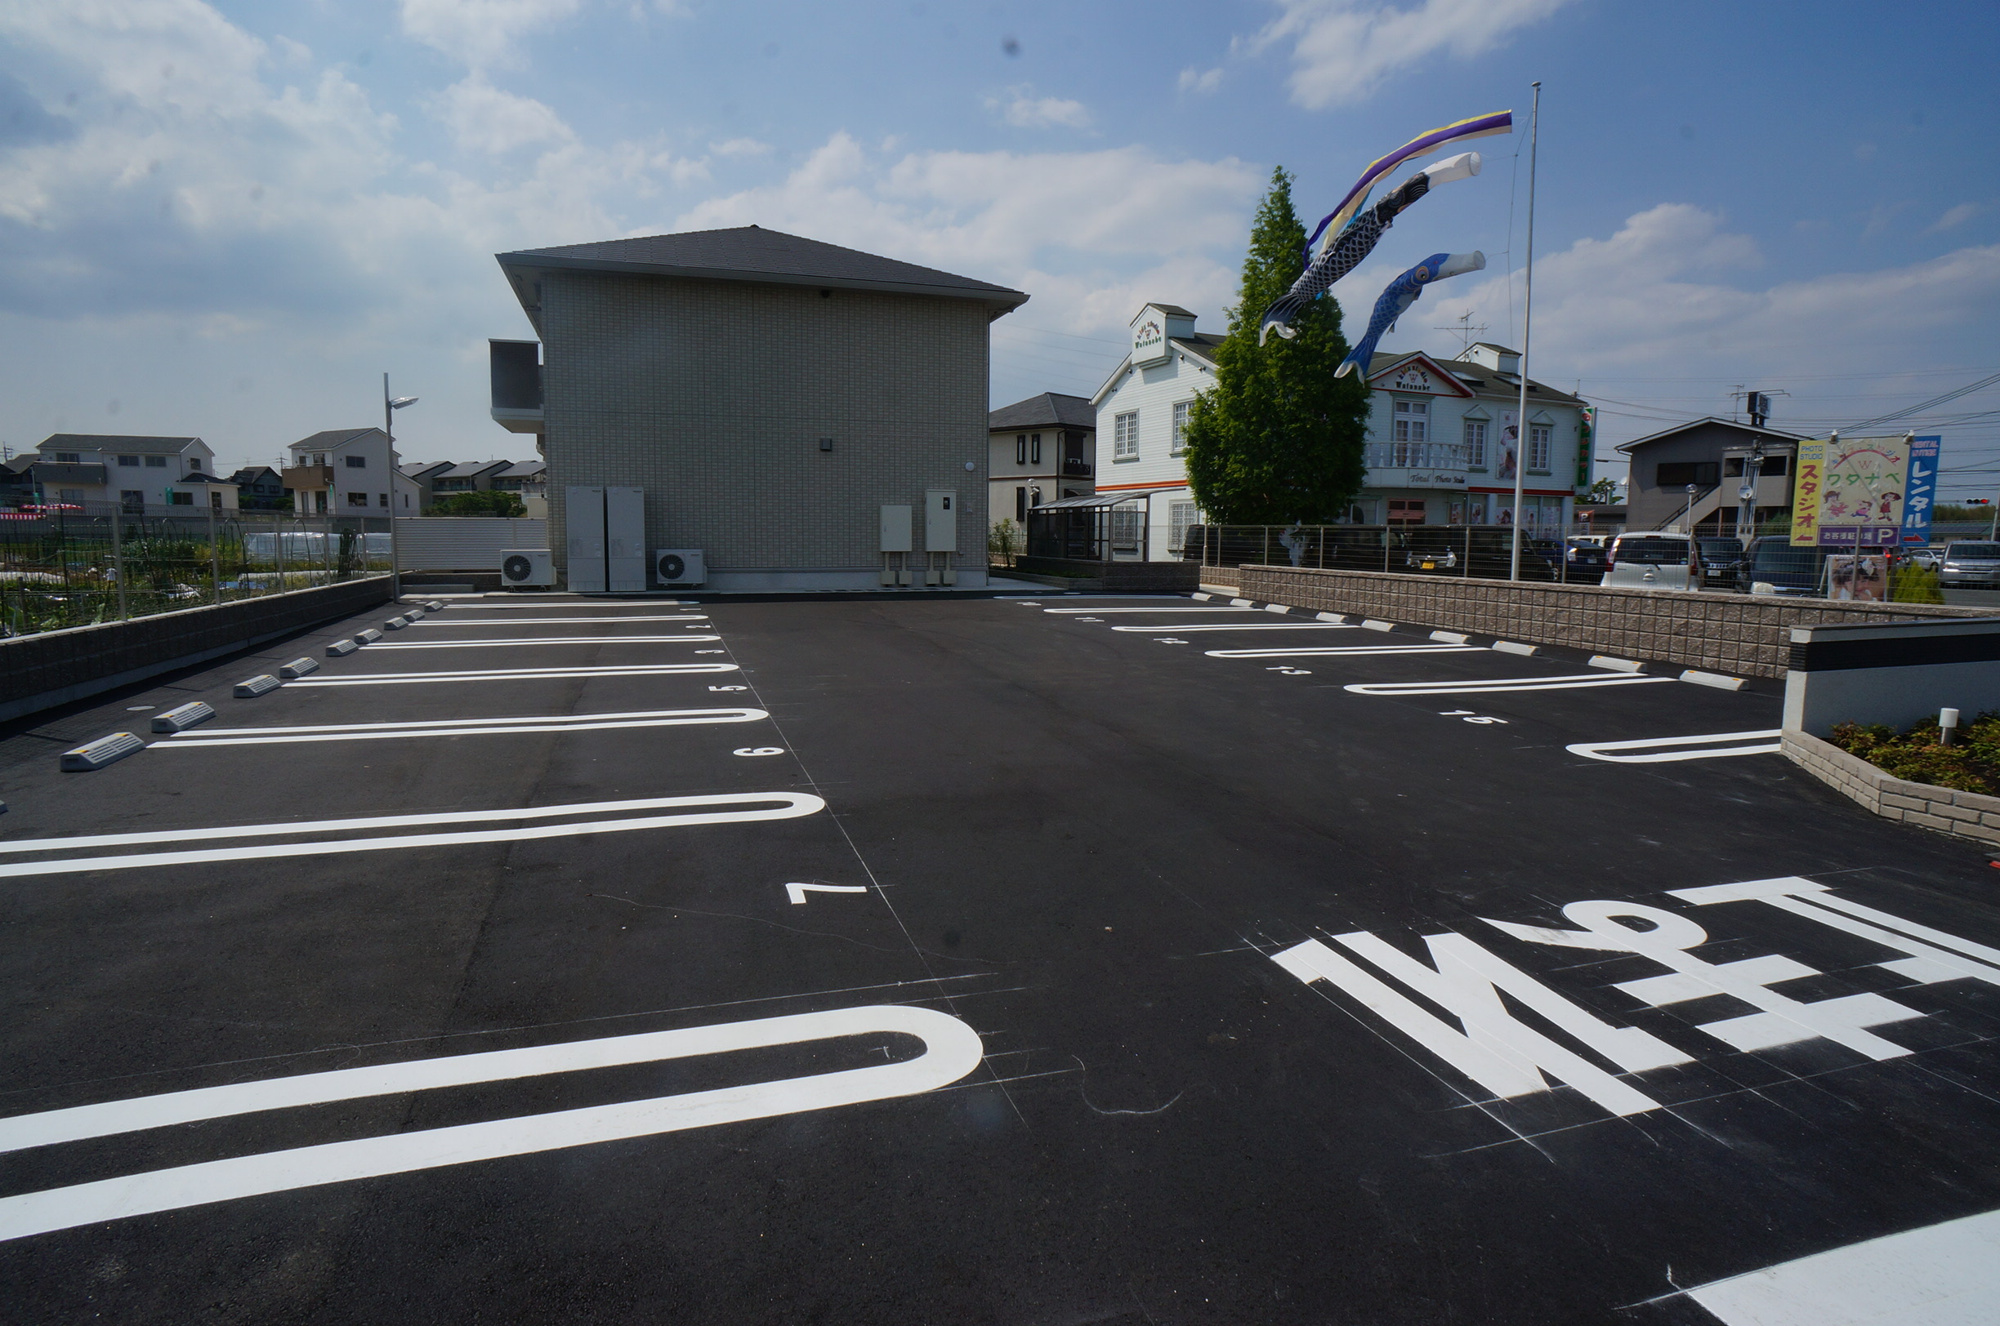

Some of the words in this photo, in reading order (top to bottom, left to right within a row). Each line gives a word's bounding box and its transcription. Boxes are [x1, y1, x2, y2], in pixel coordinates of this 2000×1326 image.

[1135, 337, 1161, 349] Watanabe
[1395, 381, 1431, 392] Watanabe
[1579, 425, 1590, 481] フジカラー
[1800, 445, 1824, 453] PHOTO
[1799, 453, 1823, 461] STUDIO
[1410, 473, 1432, 483] Total
[1827, 472, 1902, 486] ワタナベ
[1796, 464, 1819, 529] スタジオ
[1904, 461, 1933, 529] レンタル
[1823, 531, 1873, 541] お客様駐場
[1877, 528, 1894, 544] P
[733, 746, 785, 757] 6
[785, 882, 868, 905] 7
[1270, 875, 2000, 1117] 止まれ
